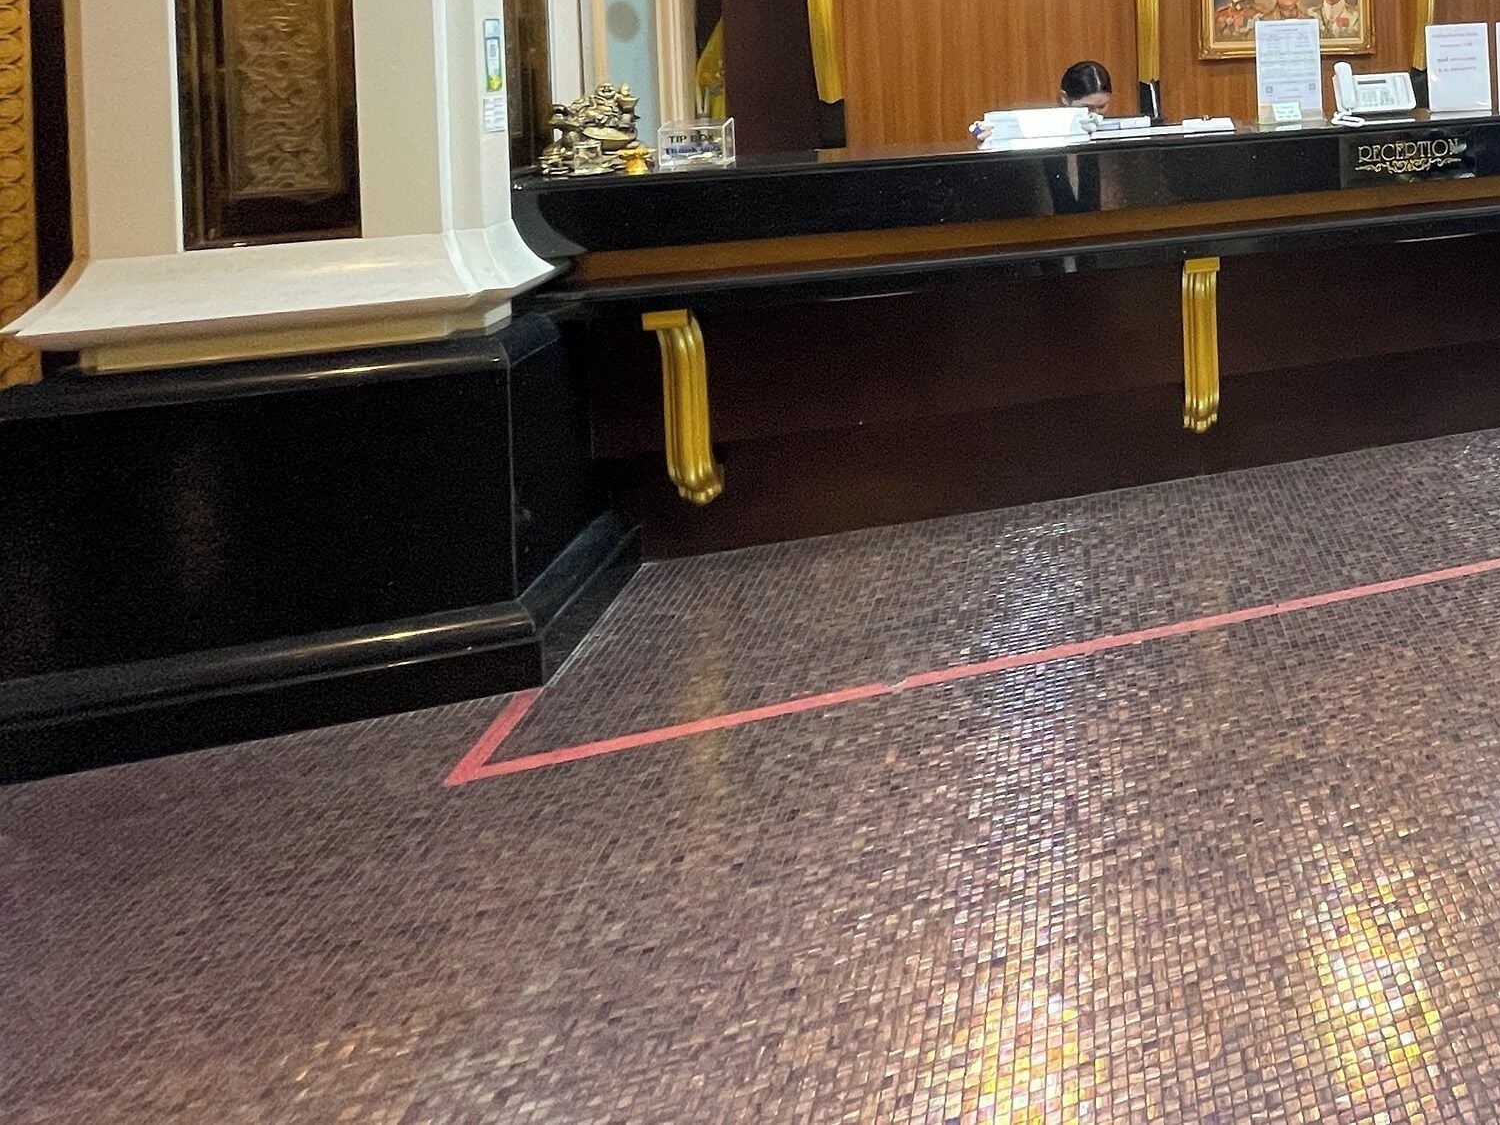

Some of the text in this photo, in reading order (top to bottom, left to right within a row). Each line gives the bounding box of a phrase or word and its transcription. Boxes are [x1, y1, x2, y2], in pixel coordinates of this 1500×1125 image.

[668, 134, 714, 143] TIP BOX
[1358, 139, 1459, 163] RECEPTION
